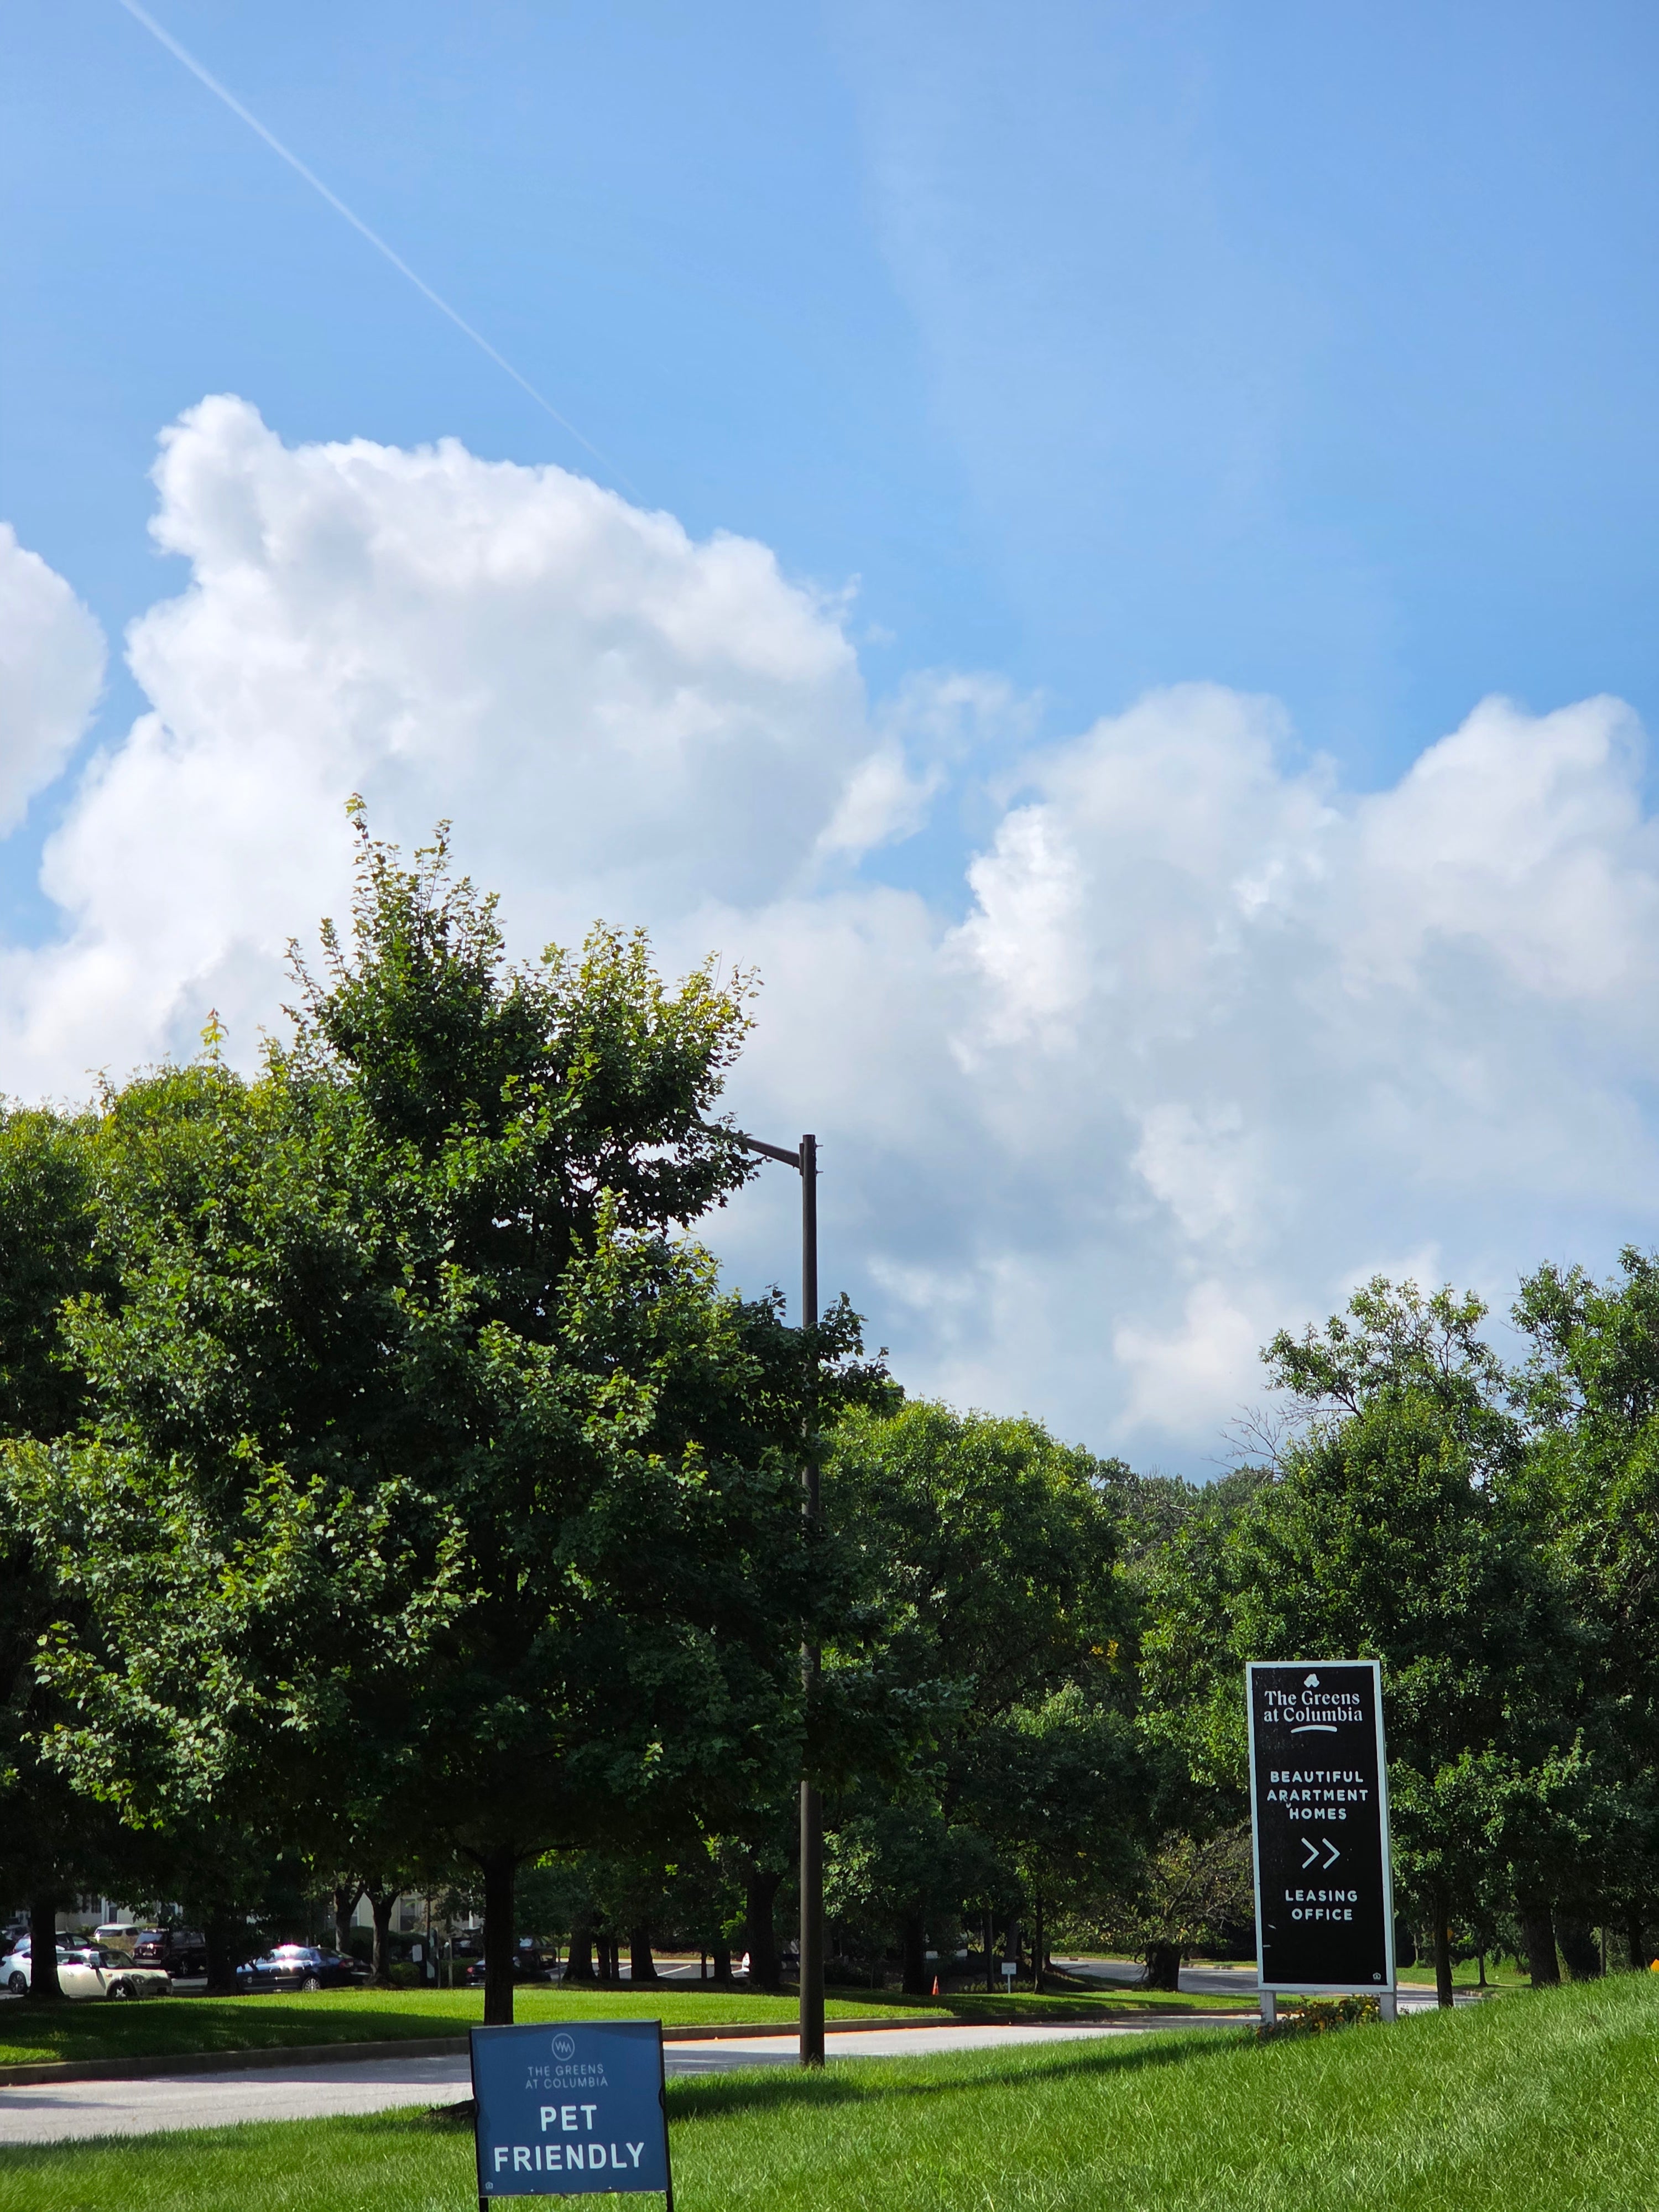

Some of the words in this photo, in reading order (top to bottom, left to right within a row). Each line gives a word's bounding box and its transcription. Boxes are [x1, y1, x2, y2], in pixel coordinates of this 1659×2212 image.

[1265, 1691, 1297, 1705] The
[1301, 1690, 1360, 1705] Greens
[1264, 1709, 1279, 1722] at
[1283, 1707, 1363, 1722] Columbia
[1270, 1771, 1364, 1783] BEAUTIFUL
[1289, 1808, 1347, 1820] HOMES
[1285, 1890, 1358, 1902] LEASING
[1291, 1908, 1353, 1921] OFFICE
[528, 2066, 550, 2077] THE
[555, 2064, 604, 2077] GREENS
[525, 2079, 538, 2089] AT
[544, 2076, 608, 2089] COLUMBIA
[540, 2105, 597, 2132] PET
[494, 2142, 645, 2172] FRIENDLY
